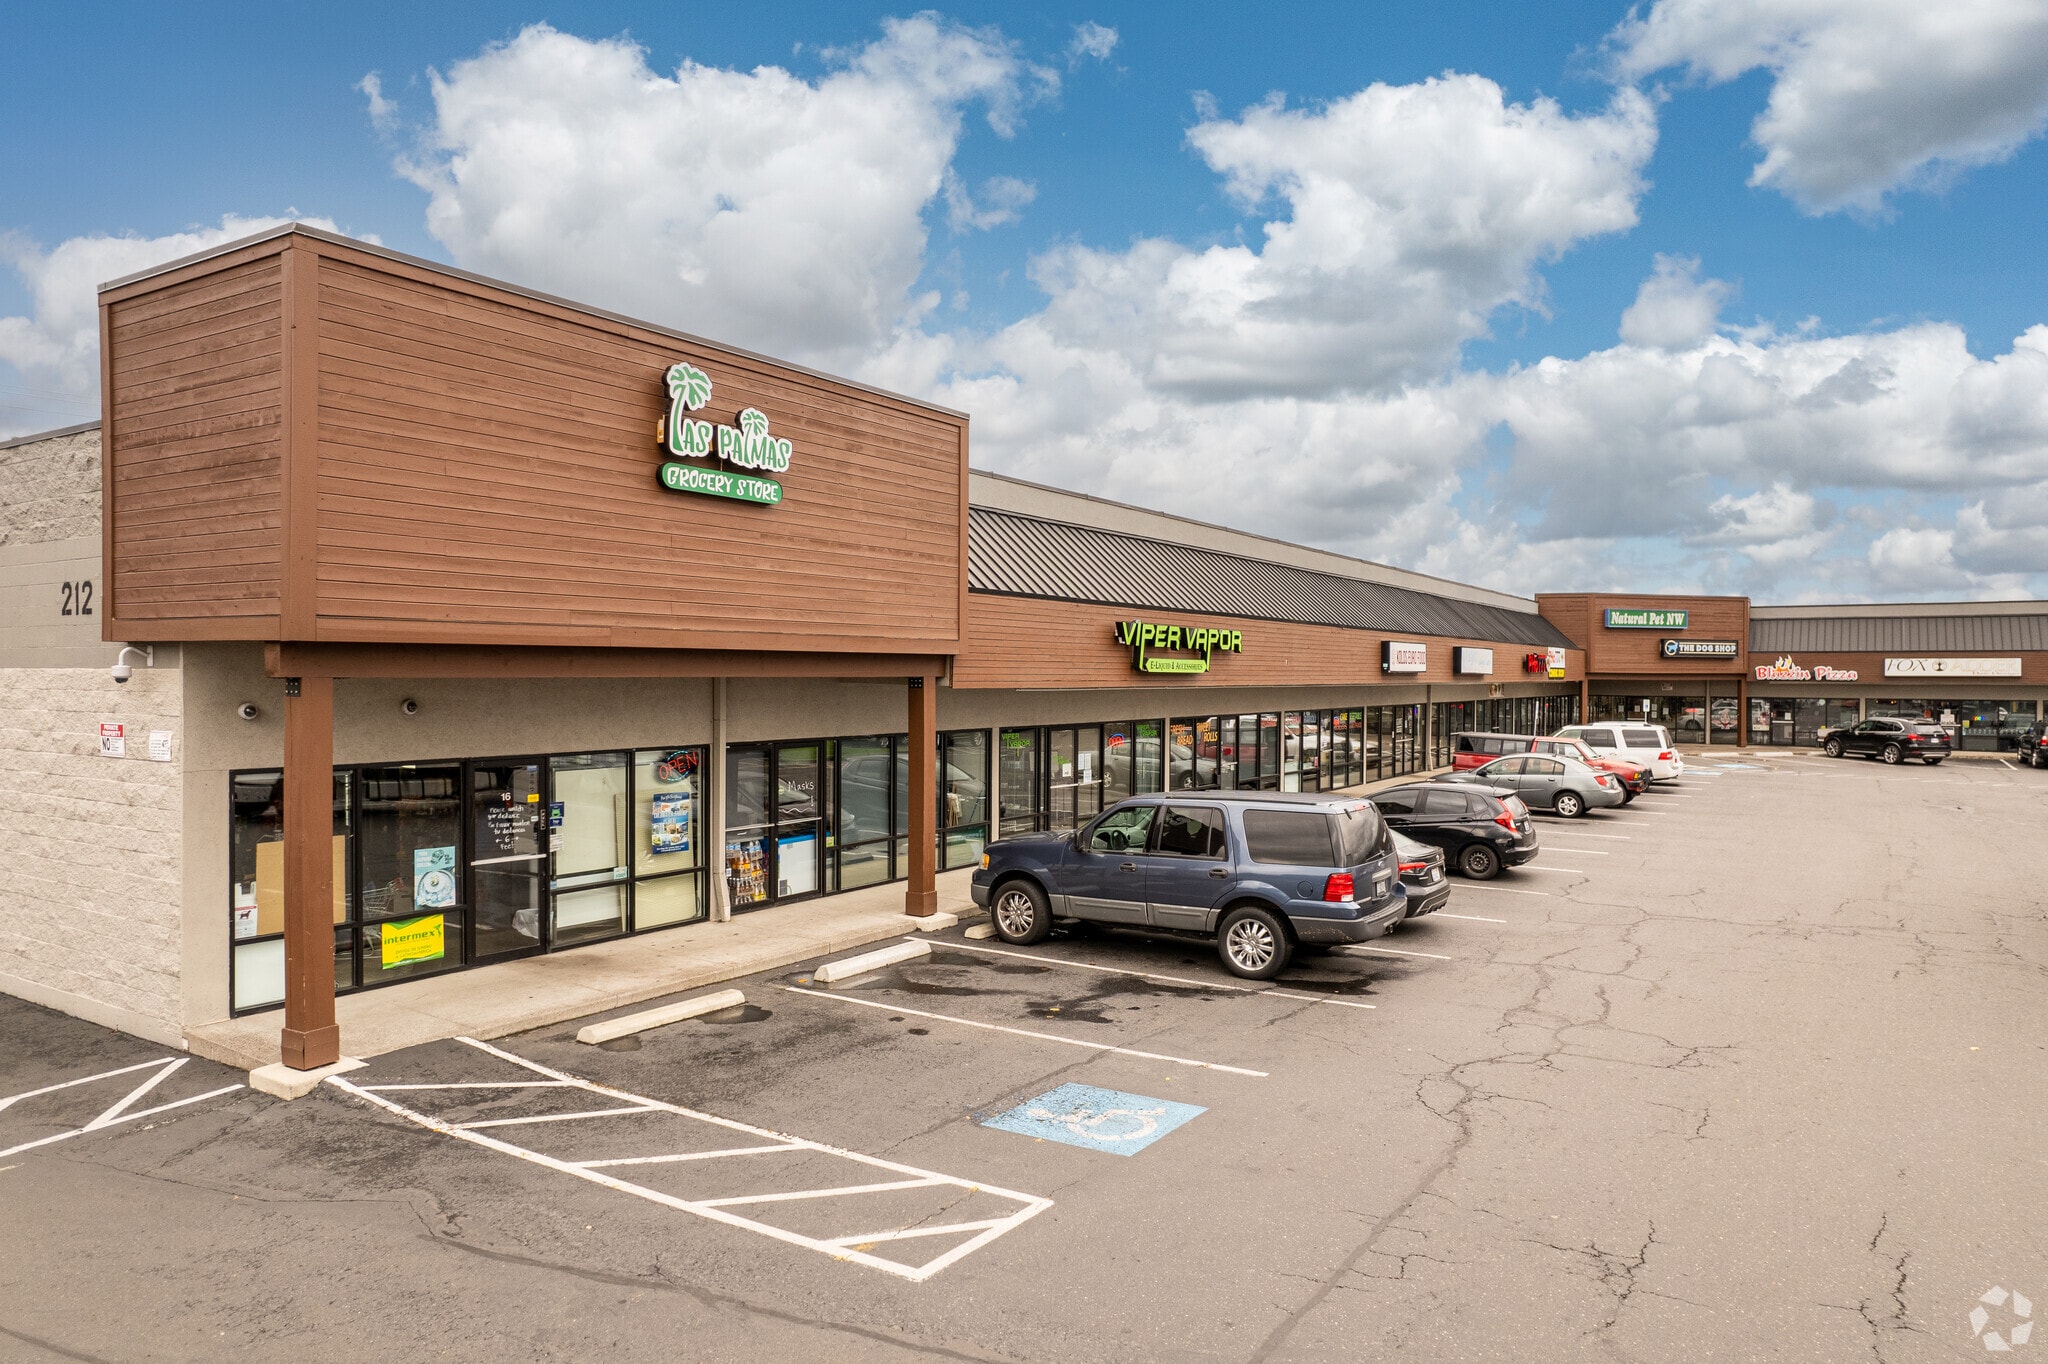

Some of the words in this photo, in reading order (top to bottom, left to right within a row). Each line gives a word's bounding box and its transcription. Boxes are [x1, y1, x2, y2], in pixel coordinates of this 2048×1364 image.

[718, 408, 792, 472] PALMAS
[667, 467, 733, 493] GROCERY
[736, 479, 778, 502] STORE
[61, 581, 93, 616] 212
[1611, 611, 1647, 625] Natural
[1649, 612, 1664, 626] Pet
[1666, 613, 1685, 626] NW
[1122, 620, 1181, 671] VIPER
[1186, 627, 1242, 671] VAPOR
[1679, 644, 1695, 652] THE
[1696, 644, 1714, 652] DOG
[1714, 645, 1736, 653] SHOP
[1814, 666, 1858, 680] Pizza
[1176, 736, 1194, 746] BREAD
[1204, 732, 1218, 742] ROLLS
[659, 751, 698, 780] OPEN
[788, 780, 814, 792] Masks
[501, 792, 512, 801] 16
[384, 930, 434, 944] intermex
